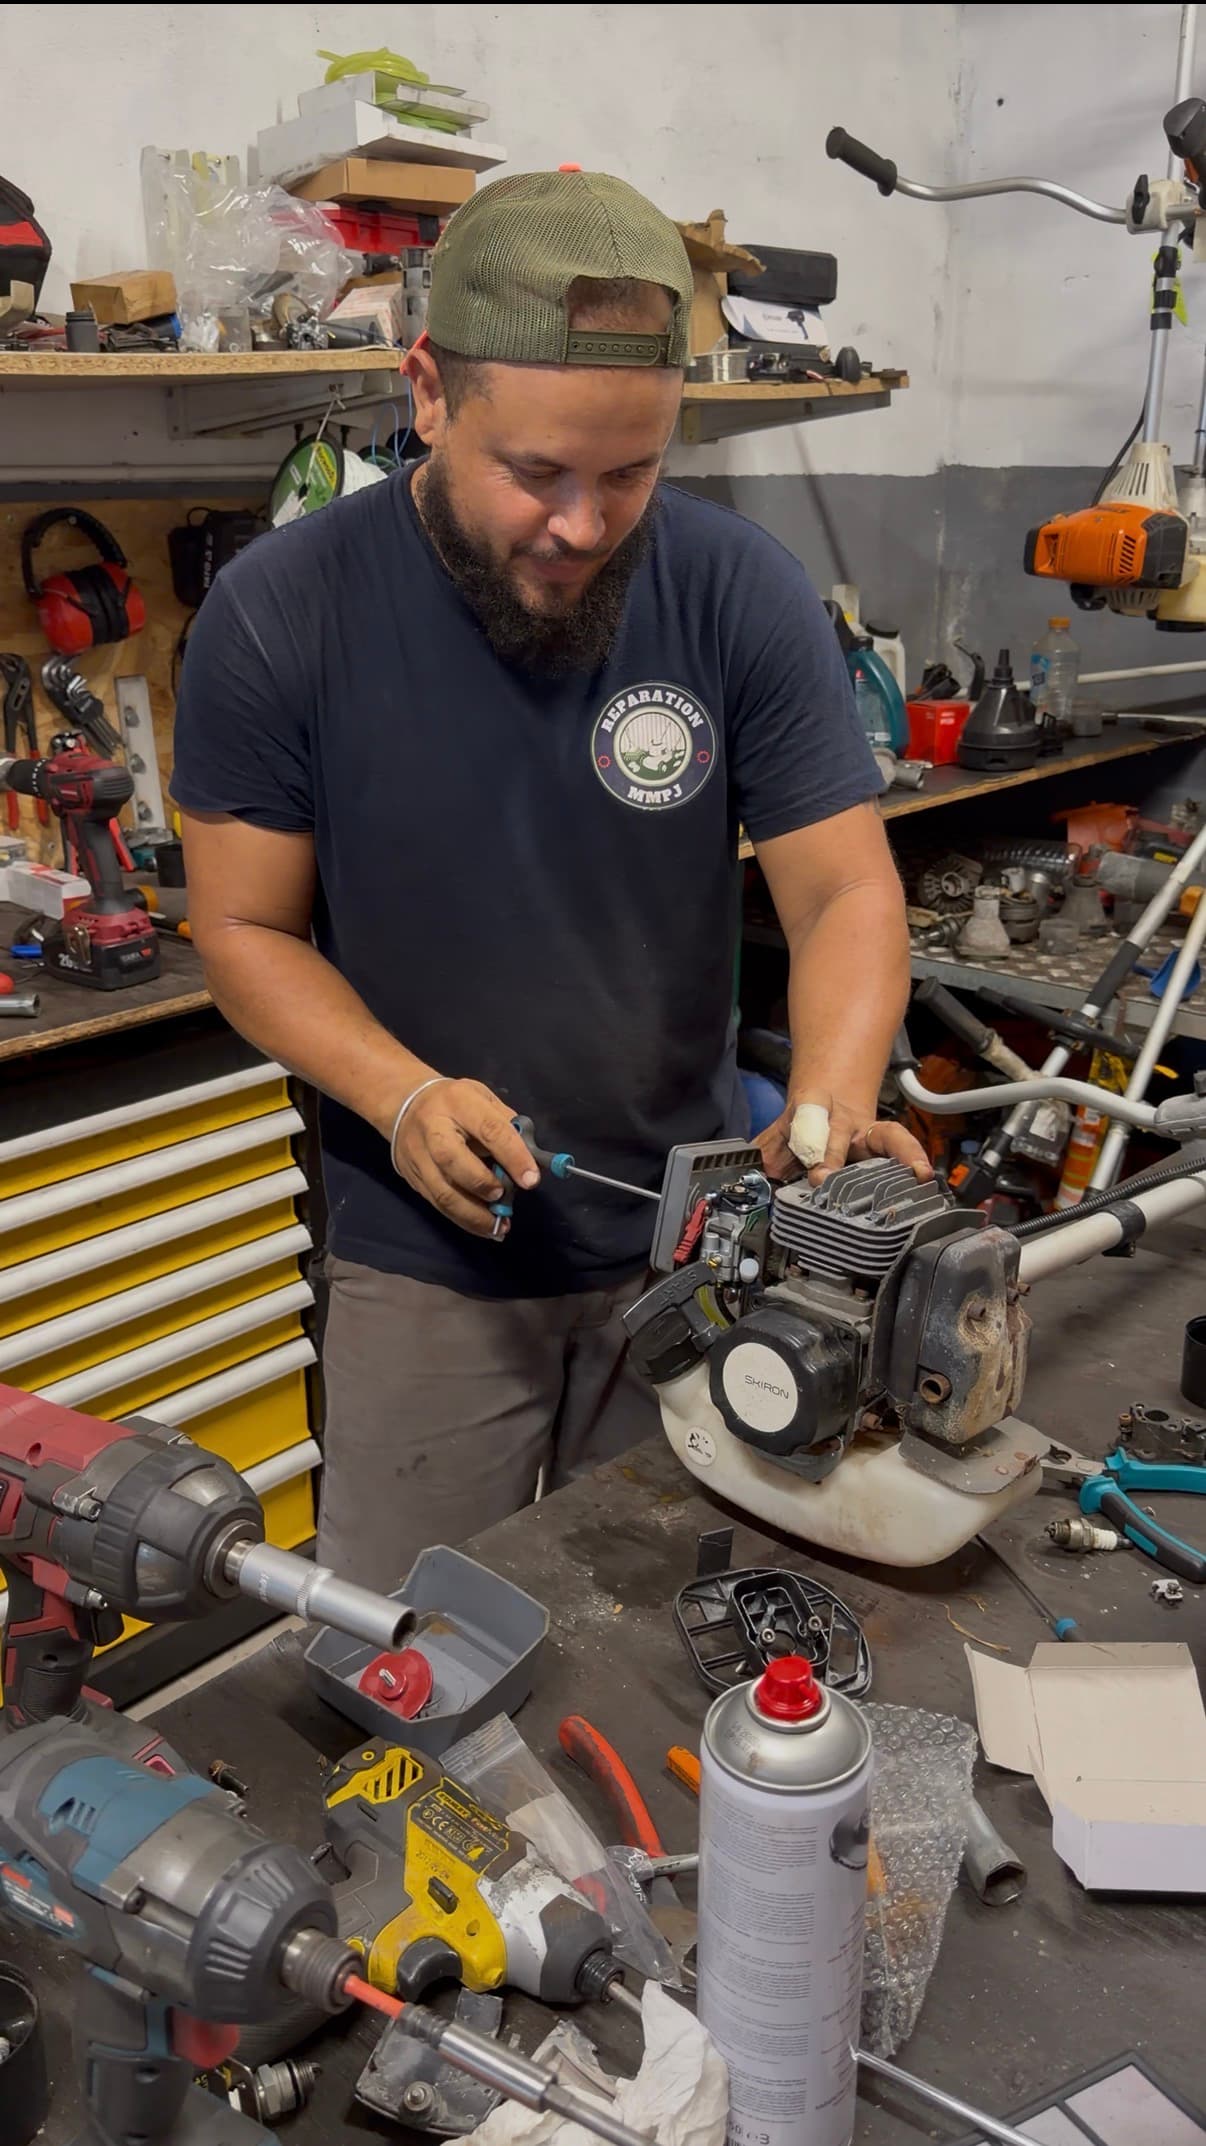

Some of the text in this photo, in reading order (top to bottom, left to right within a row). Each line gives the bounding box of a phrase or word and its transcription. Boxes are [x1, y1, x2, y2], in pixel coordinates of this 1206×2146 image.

[601, 689, 704, 733] REPARATION
[627, 784, 683, 803] MMPJ
[744, 1374, 789, 1399] SKIRON
